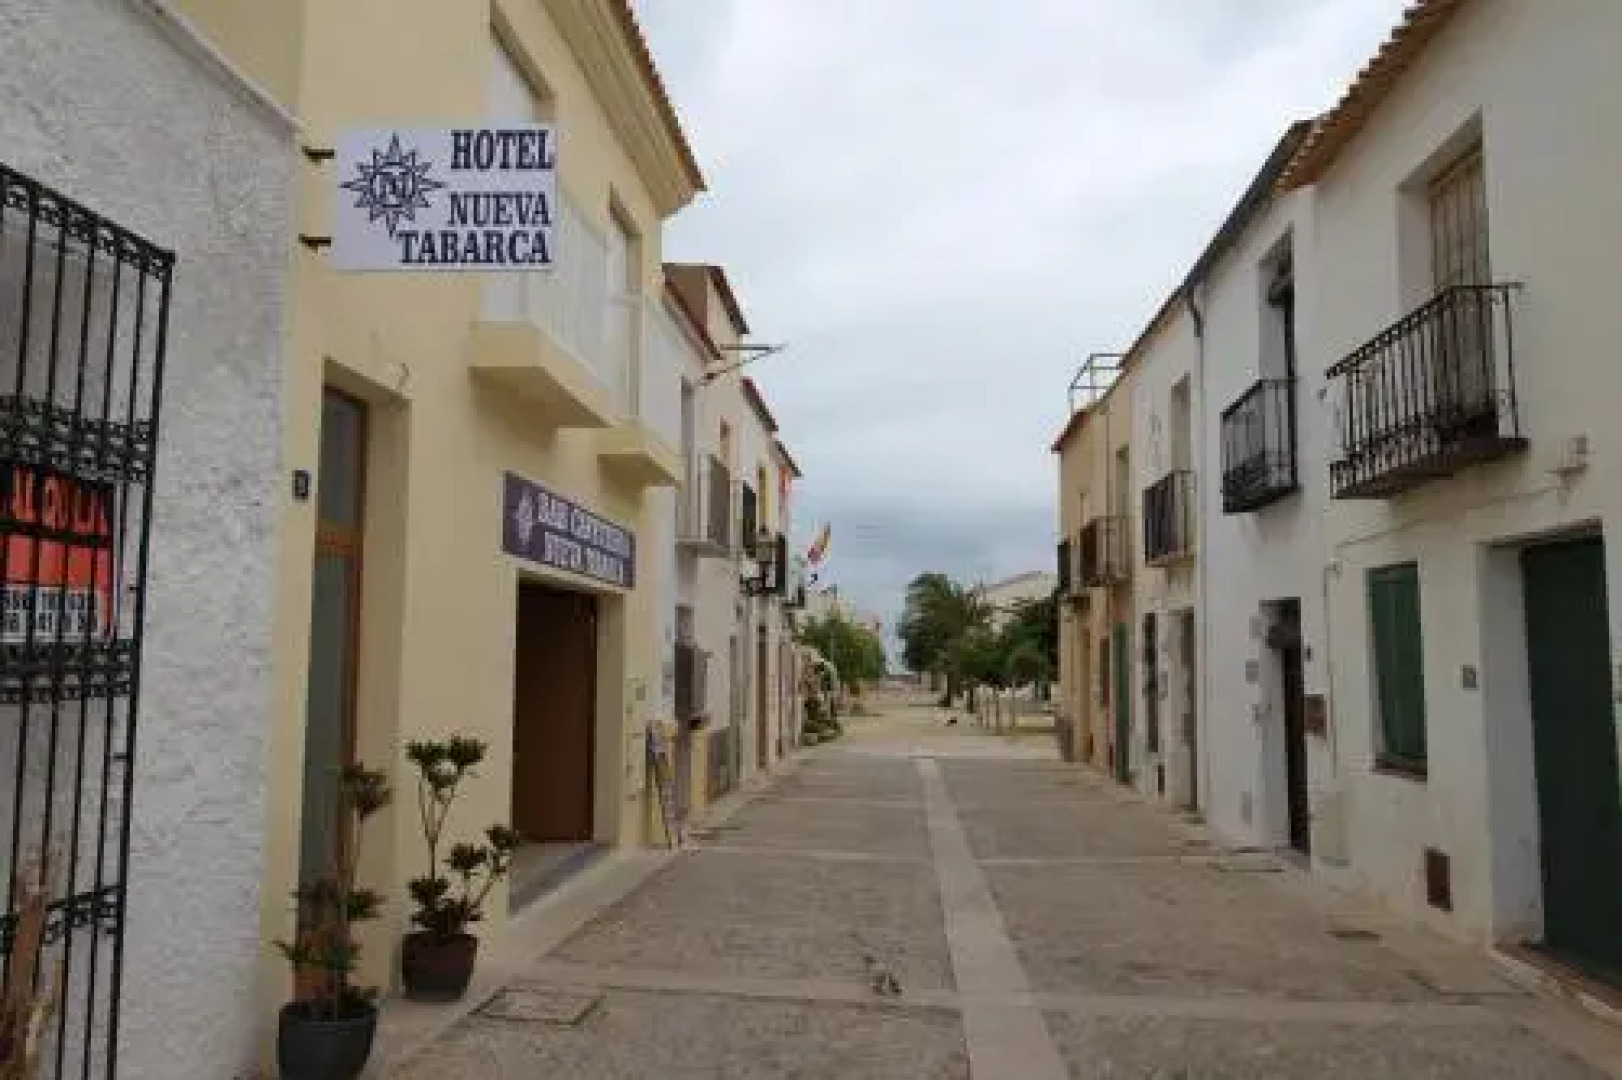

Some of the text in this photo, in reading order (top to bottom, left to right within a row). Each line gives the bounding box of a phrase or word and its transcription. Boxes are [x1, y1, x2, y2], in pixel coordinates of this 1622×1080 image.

[451, 129, 553, 170] HOTEL
[448, 191, 552, 228] NUEVA
[398, 229, 552, 264] TABARCA
